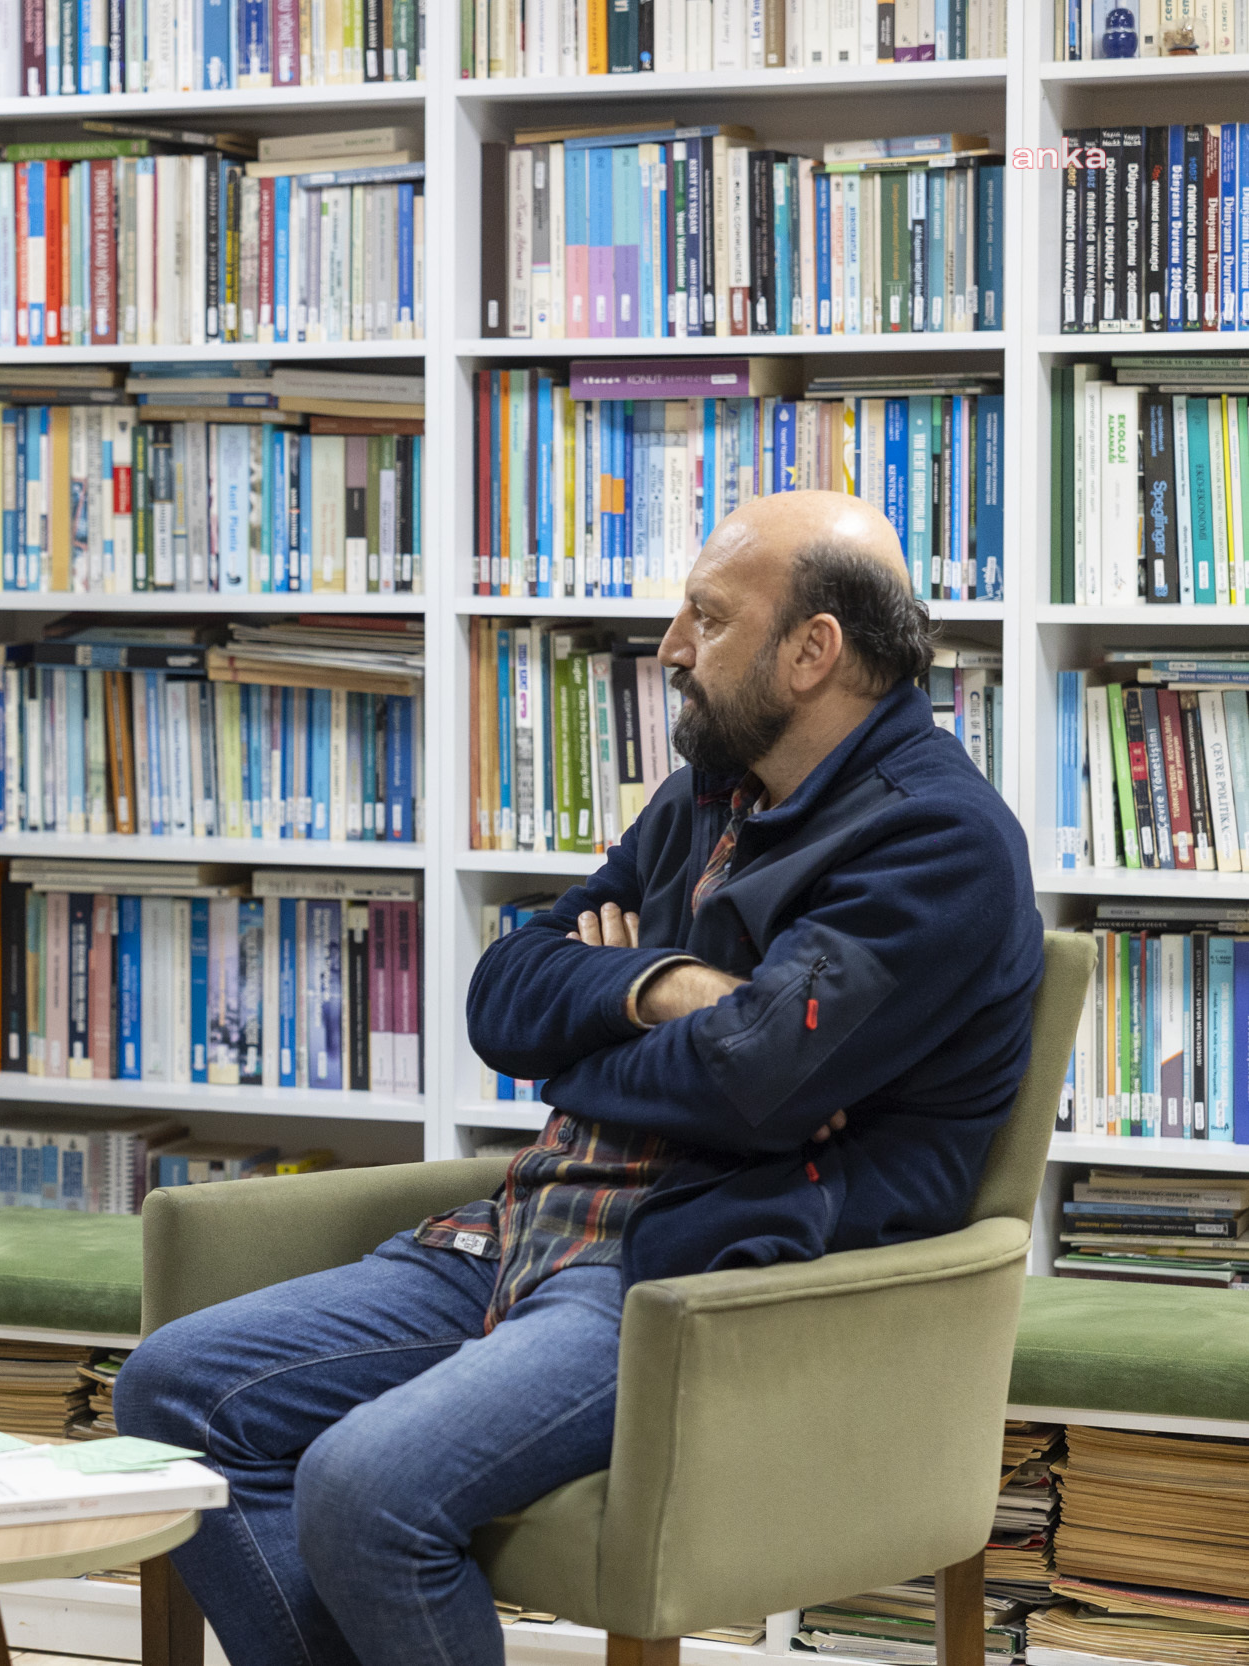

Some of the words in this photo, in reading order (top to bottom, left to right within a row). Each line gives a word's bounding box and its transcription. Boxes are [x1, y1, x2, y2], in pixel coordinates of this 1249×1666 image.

[1065, 189, 1077, 240] DURUMU
[1105, 157, 1116, 223] DÜNYANIN
[1126, 163, 1139, 218] Dünyanın
[1151, 181, 1160, 222] DURUMU
[1170, 164, 1182, 218] Dünyanın
[1186, 184, 1198, 236] DURUMU
[1086, 191, 1096, 242] DURUMU
[1207, 197, 1219, 251] Dünyanın
[1222, 196, 1235, 253] Dünyanın
[1105, 225, 1116, 279] DURUMU
[1127, 219, 1139, 266] Durumu
[1149, 222, 1160, 272] DÜNYANIN
[1171, 220, 1182, 264] Durumu
[1117, 413, 1128, 463] EKOLOJİ
[1150, 480, 1168, 555] Speglingar
[571, 657, 583, 684] Gugler
[578, 689, 588, 711] Cities
[579, 721, 589, 733] the
[578, 735, 589, 776] Developing
[1147, 727, 1165, 793] Yönetişimi
[1210, 742, 1226, 779] ÇEVRE
[581, 776, 590, 799] World
